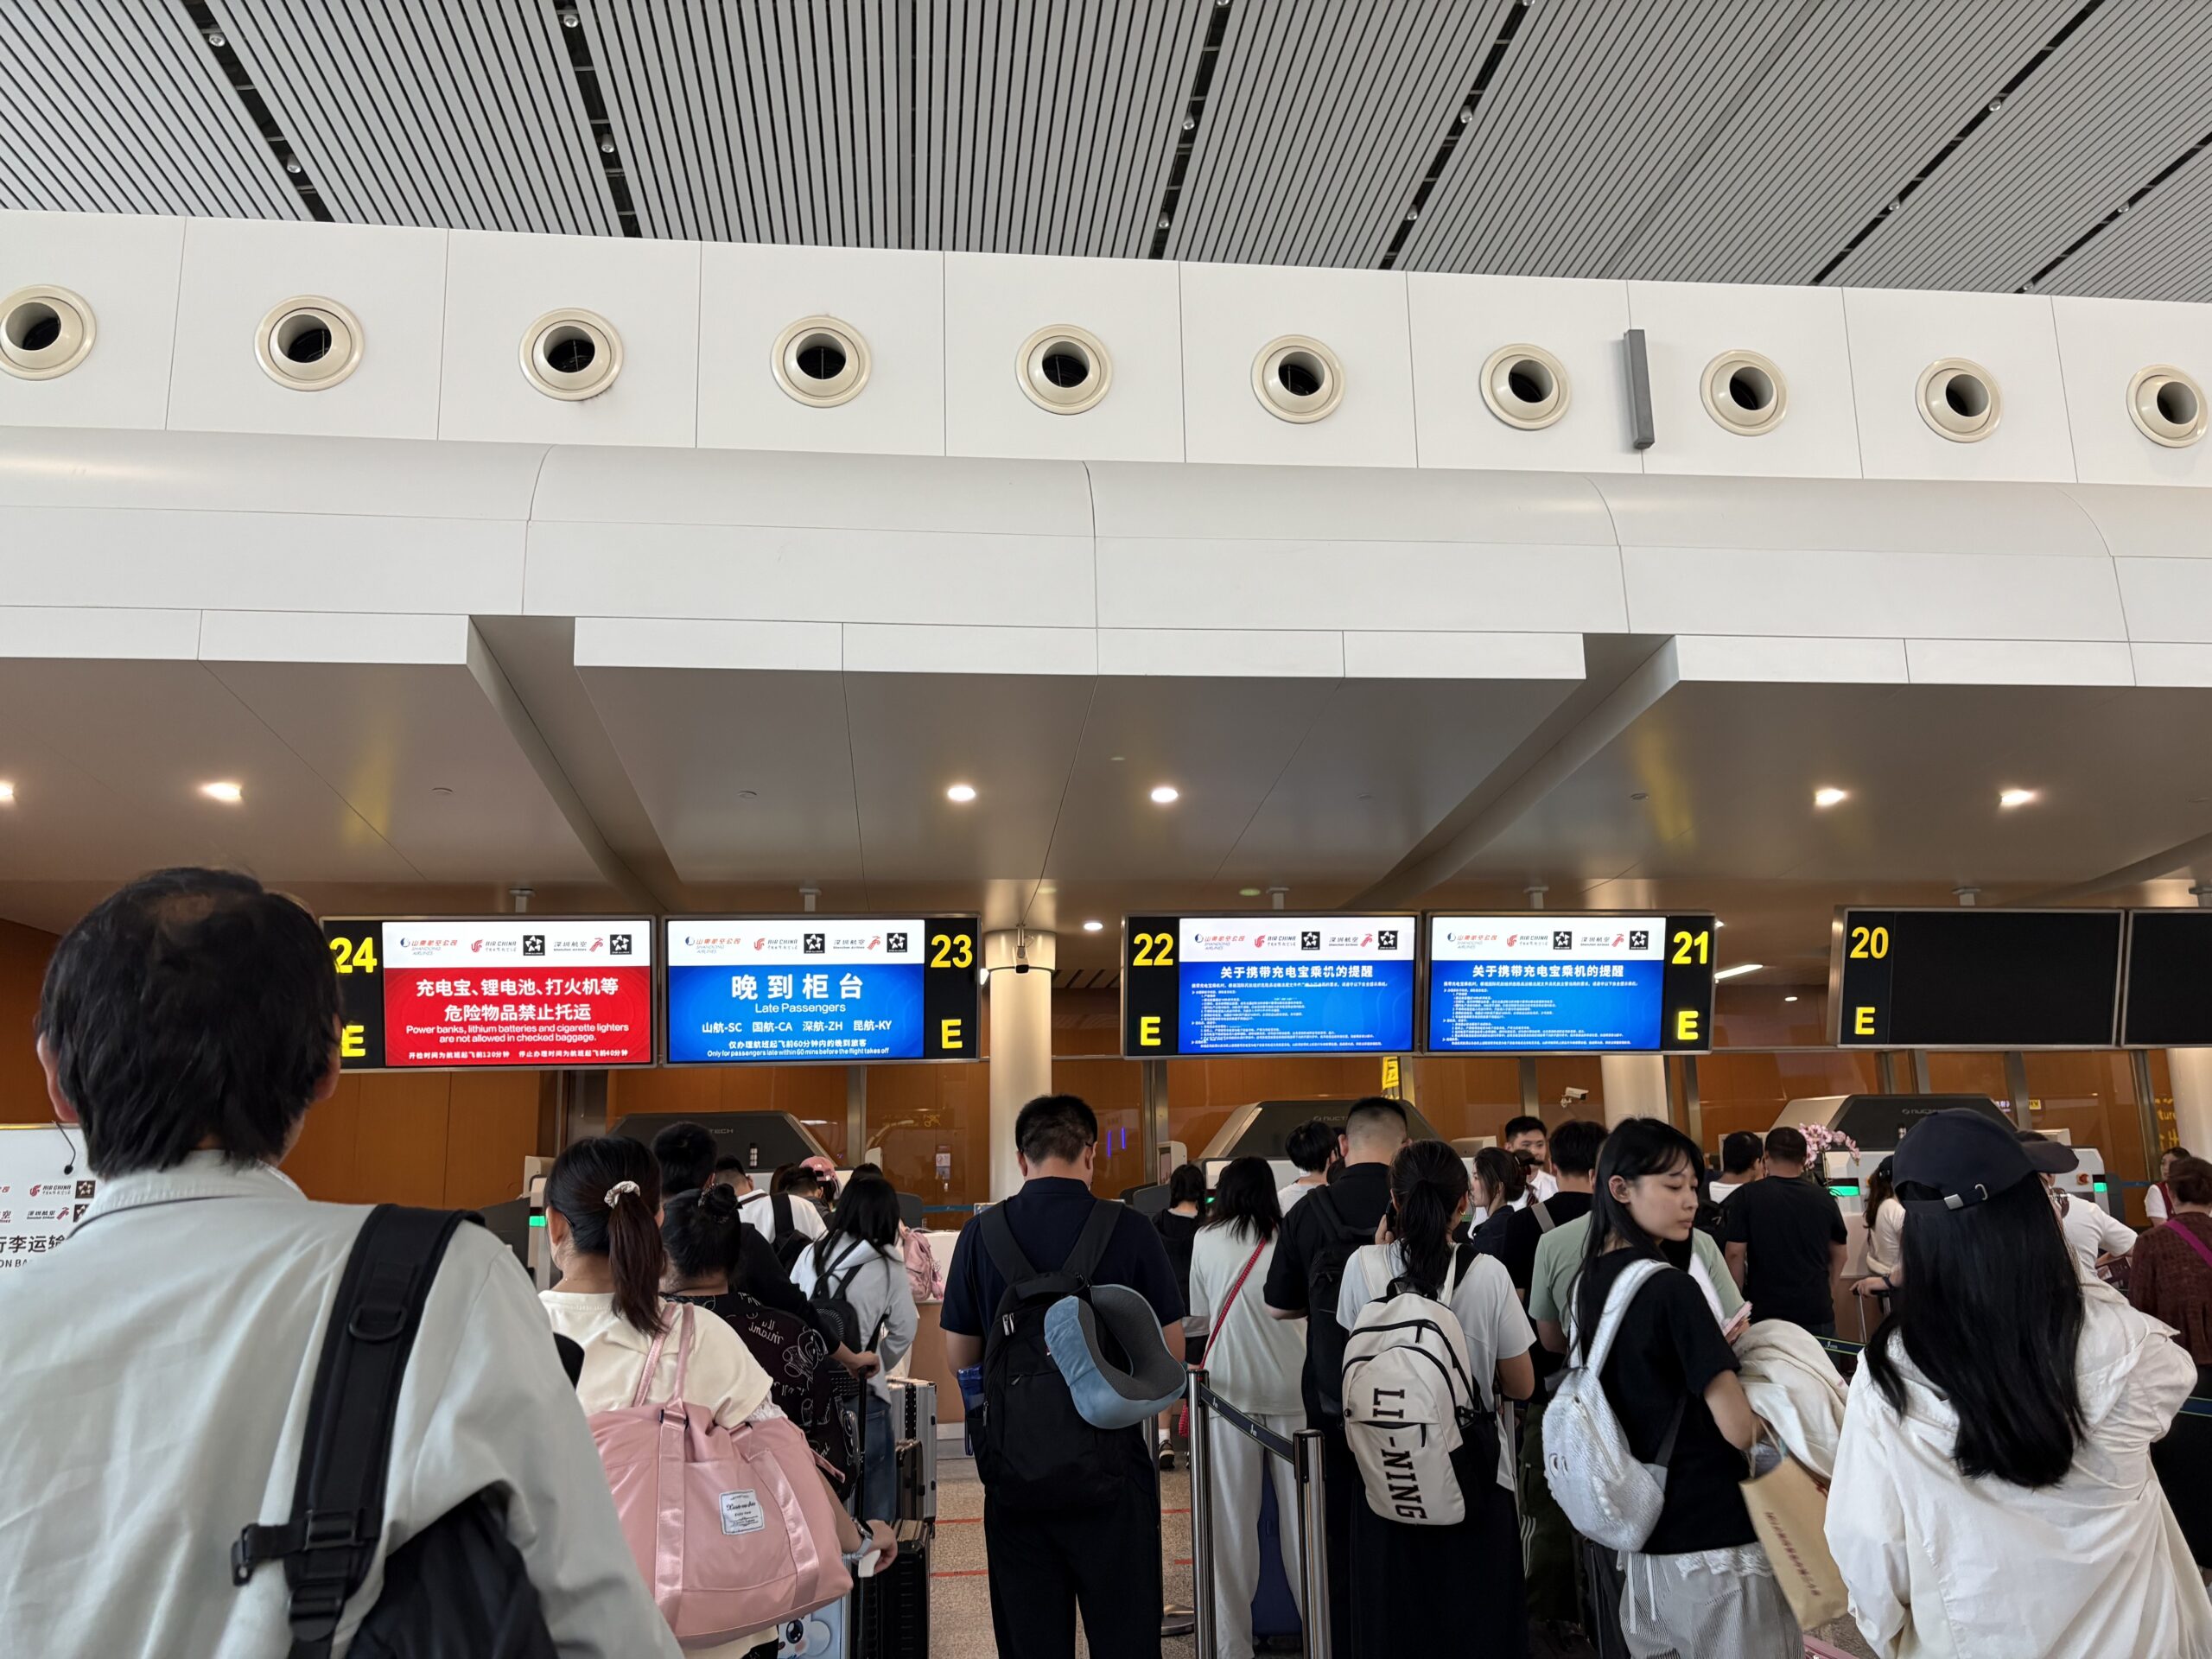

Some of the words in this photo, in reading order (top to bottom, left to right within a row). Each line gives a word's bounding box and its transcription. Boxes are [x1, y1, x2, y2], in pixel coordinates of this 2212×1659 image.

[329, 938, 377, 973] 24
[931, 934, 972, 968] 23
[1133, 933, 1173, 966] 22
[1672, 931, 1708, 964] 21
[1850, 926, 1889, 959] 20
[1221, 965, 1373, 979] 关于携带充电宝乘机的提醒
[1472, 964, 1624, 977] 关于携带充电宝乘机的提醒
[416, 977, 619, 997] 充电宝、锂电池、打火机等
[732, 973, 863, 1000] 晚到柜台
[444, 1003, 591, 1021] 危险物品禁止托运
[755, 1003, 779, 1014] Late
[781, 1003, 846, 1014] Passengers
[1854, 1007, 1875, 1035] E
[436, 1026, 467, 1034] banks,
[556, 1024, 595, 1033] cigarette
[596, 1023, 629, 1033] lighters
[555, 1033, 596, 1043] baggage.
[702, 1021, 742, 1033] 山航-SC
[753, 1021, 793, 1033] 国航-CA
[803, 1020, 843, 1032] 深航-ZH
[853, 1020, 892, 1031] 昆航-KY
[942, 1020, 963, 1048] E
[1141, 1016, 1161, 1046] E
[1677, 1010, 1699, 1040] E
[340, 1025, 365, 1057] E
[1372, 1388, 1427, 1520] LI-NING
